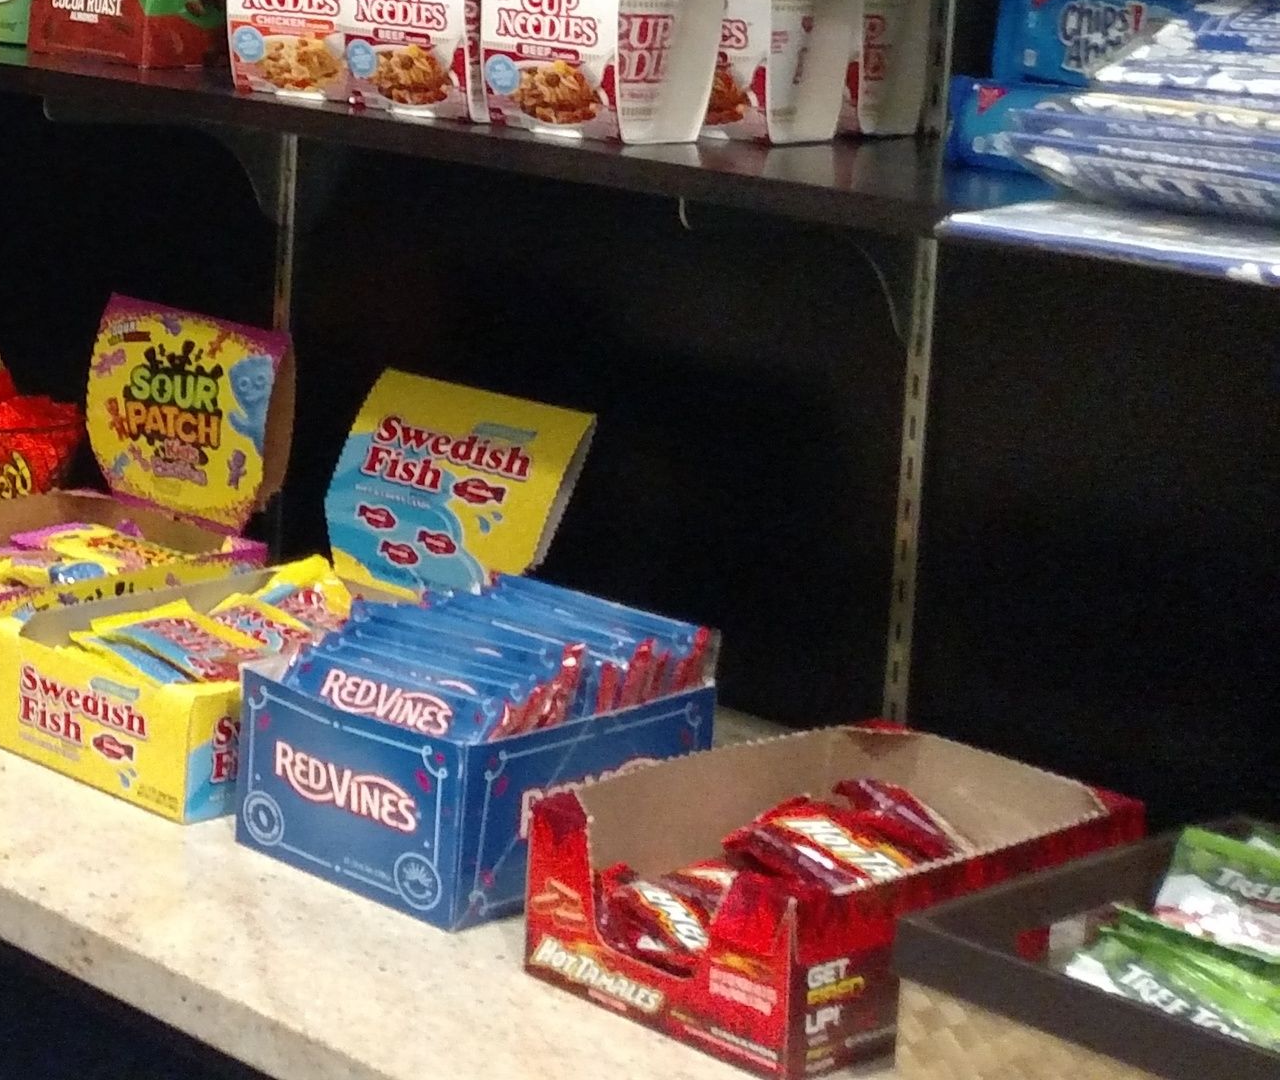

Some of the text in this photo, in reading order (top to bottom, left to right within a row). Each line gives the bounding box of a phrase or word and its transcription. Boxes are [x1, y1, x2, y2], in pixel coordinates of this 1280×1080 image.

[376, 28, 406, 43] BEEF
[496, 8, 599, 48] NOODLES
[521, 44, 552, 59] BEEF
[130, 365, 217, 413] SOUR
[125, 400, 221, 450] PATCH
[375, 415, 532, 481] Swedish
[361, 443, 445, 493] Fish
[19, 695, 85, 748] Fish
[20, 662, 147, 738] Swedish
[807, 957, 850, 990] GET
